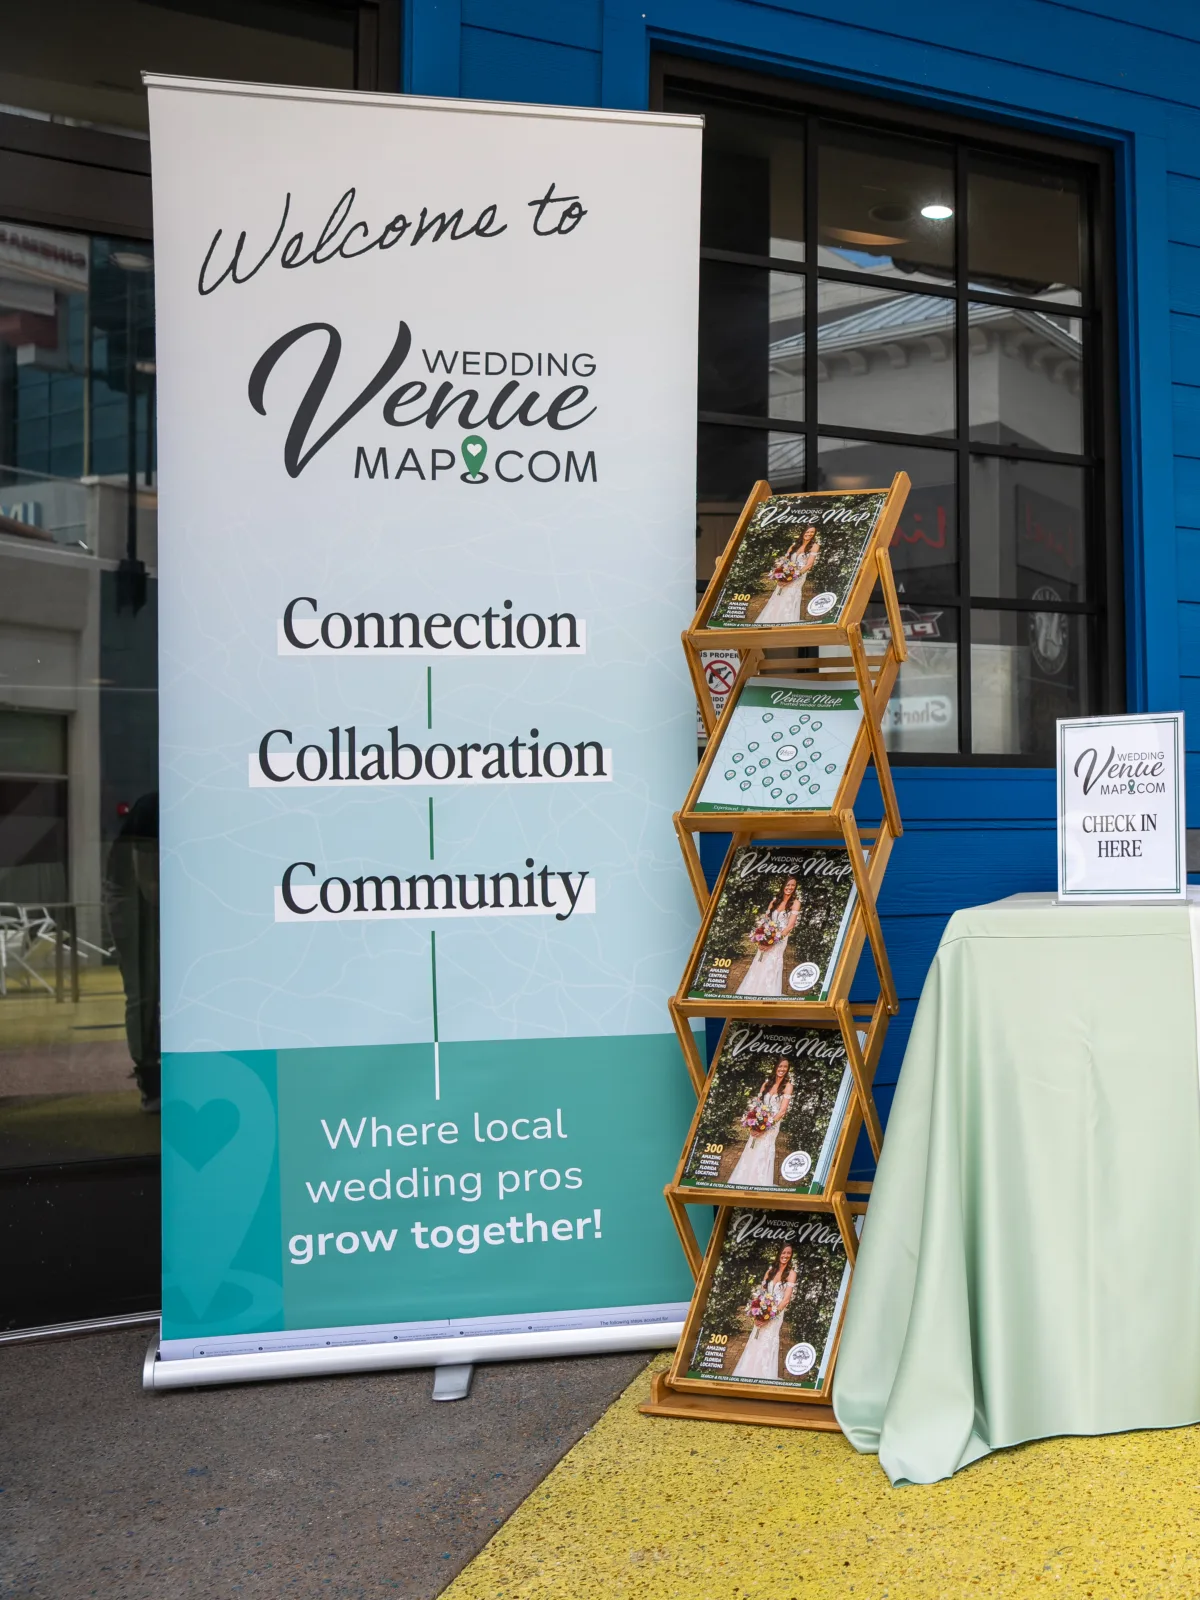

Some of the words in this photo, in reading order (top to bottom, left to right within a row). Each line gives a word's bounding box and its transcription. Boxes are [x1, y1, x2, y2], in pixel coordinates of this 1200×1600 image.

[198, 187, 508, 295] Welcome
[528, 182, 588, 236] to
[421, 348, 597, 377] WEDDING
[248, 320, 597, 478] Venue
[758, 506, 820, 528] Venue
[822, 507, 870, 527] Map
[732, 593, 751, 601] 300
[283, 596, 580, 650] Connection
[771, 690, 810, 705] Venue
[812, 694, 843, 708] Map
[258, 725, 608, 782] Collaboration
[1117, 751, 1165, 761] WEDDING
[1073, 745, 1165, 796] Venue
[1082, 814, 1136, 833] CHECK
[1140, 814, 1158, 831] IN
[1097, 840, 1143, 858] HERE
[738, 852, 800, 878] Venue
[803, 857, 852, 882] Map
[281, 857, 590, 921] Community
[713, 957, 732, 968] 300
[730, 1028, 793, 1057] Venue
[795, 1037, 846, 1065] Map
[320, 1116, 459, 1150] Where
[473, 1108, 568, 1143] local
[704, 1143, 723, 1154] 300
[305, 1167, 482, 1203] wedding
[498, 1167, 583, 1200] pros
[288, 1227, 398, 1265] grow
[410, 1208, 602, 1254] together!
[733, 1213, 796, 1243] Venue
[798, 1222, 844, 1252] Map
[766, 1219, 799, 1227] WEDDING
[708, 1333, 728, 1345] 300
